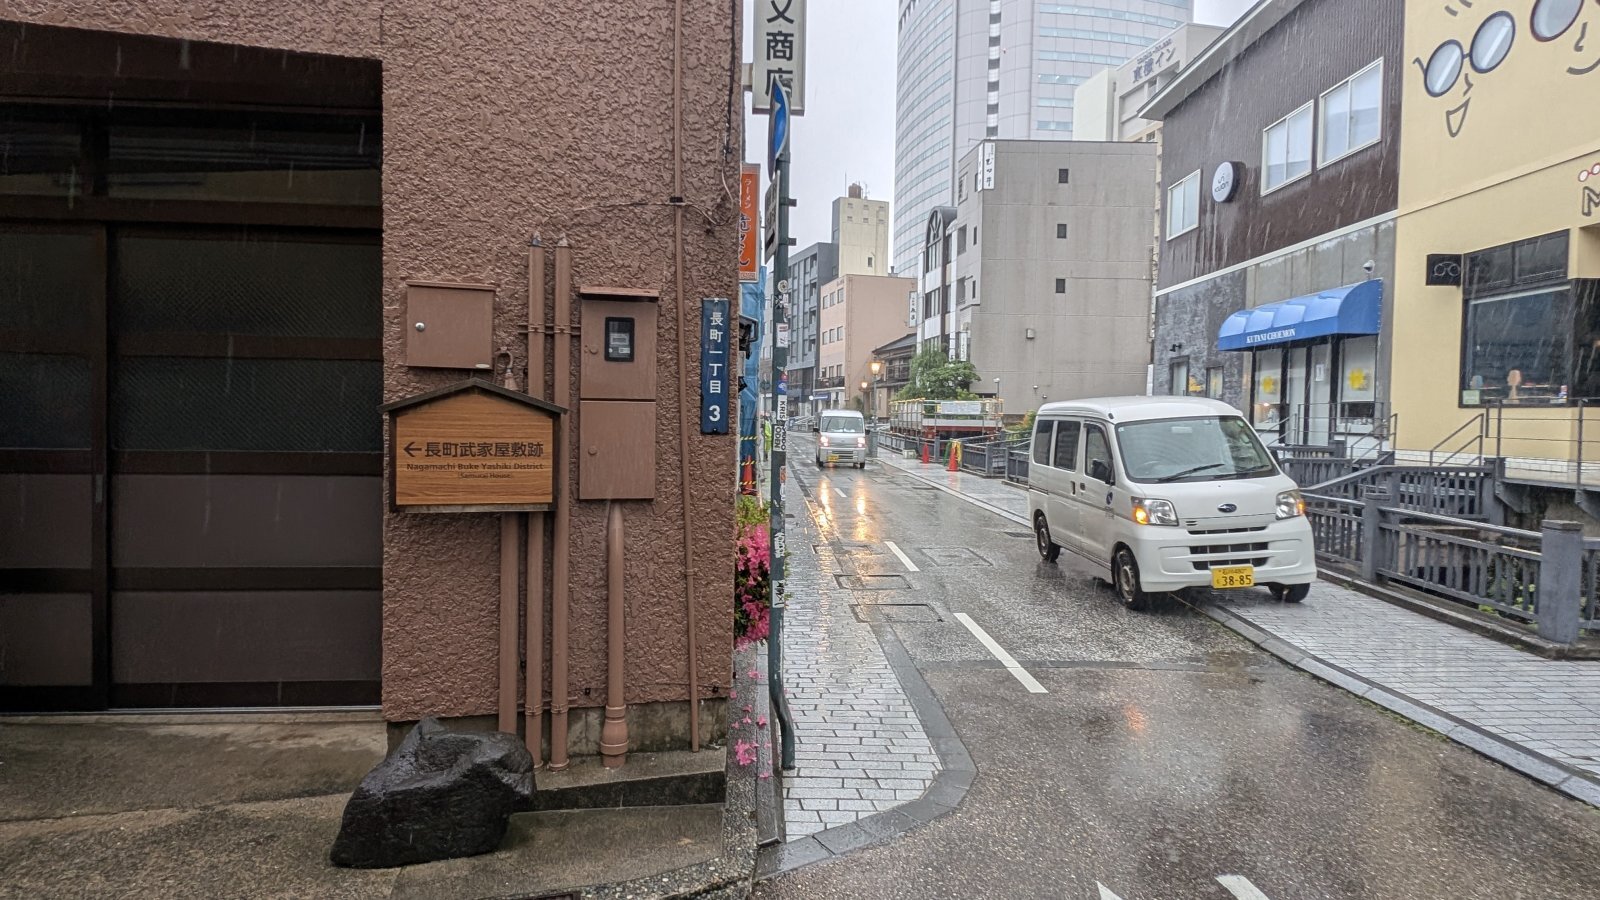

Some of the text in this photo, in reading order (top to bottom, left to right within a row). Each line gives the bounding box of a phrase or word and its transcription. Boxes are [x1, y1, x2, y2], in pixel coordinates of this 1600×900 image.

[744, 178, 752, 209] ラーメン
[424, 441, 544, 458] 長町武家屋敷跡
[406, 462, 544, 472] Nagamachi Buke Yashiki District
[1221, 574, 1253, 587] 38-85
